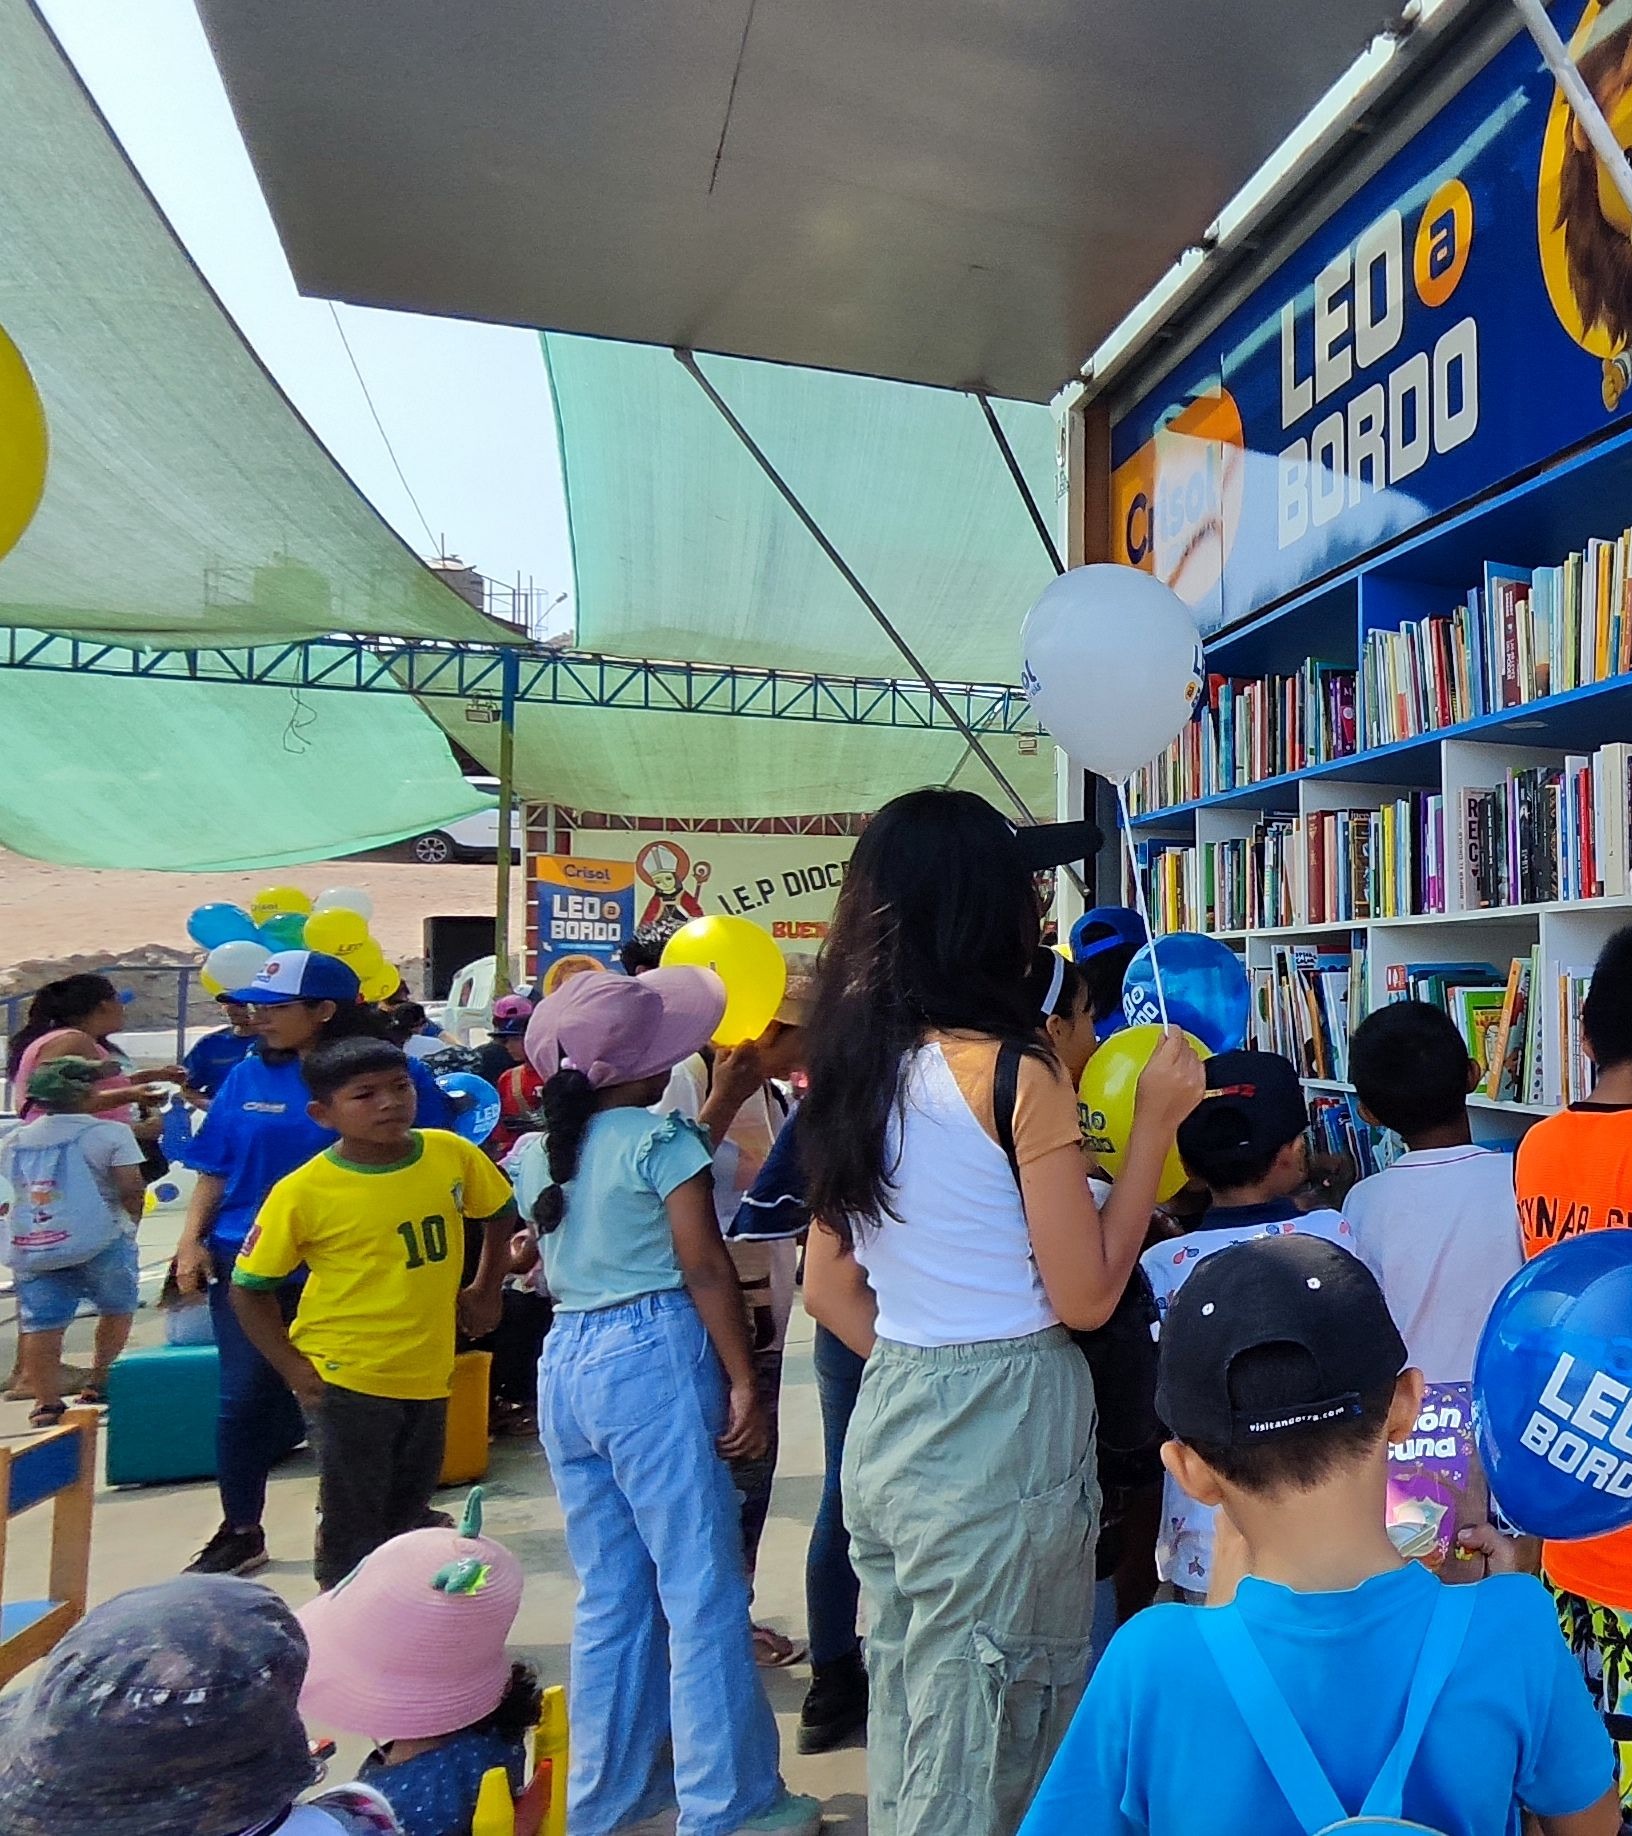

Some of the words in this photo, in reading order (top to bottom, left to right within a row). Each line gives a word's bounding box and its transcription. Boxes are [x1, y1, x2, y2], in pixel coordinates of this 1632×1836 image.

[1281, 208, 1403, 431] LEO
[1278, 316, 1478, 551] BORDO
[563, 863, 612, 881] Crisol
[552, 894, 600, 920] LEO
[551, 920, 621, 942] BORDO
[397, 1214, 448, 1269] 10
